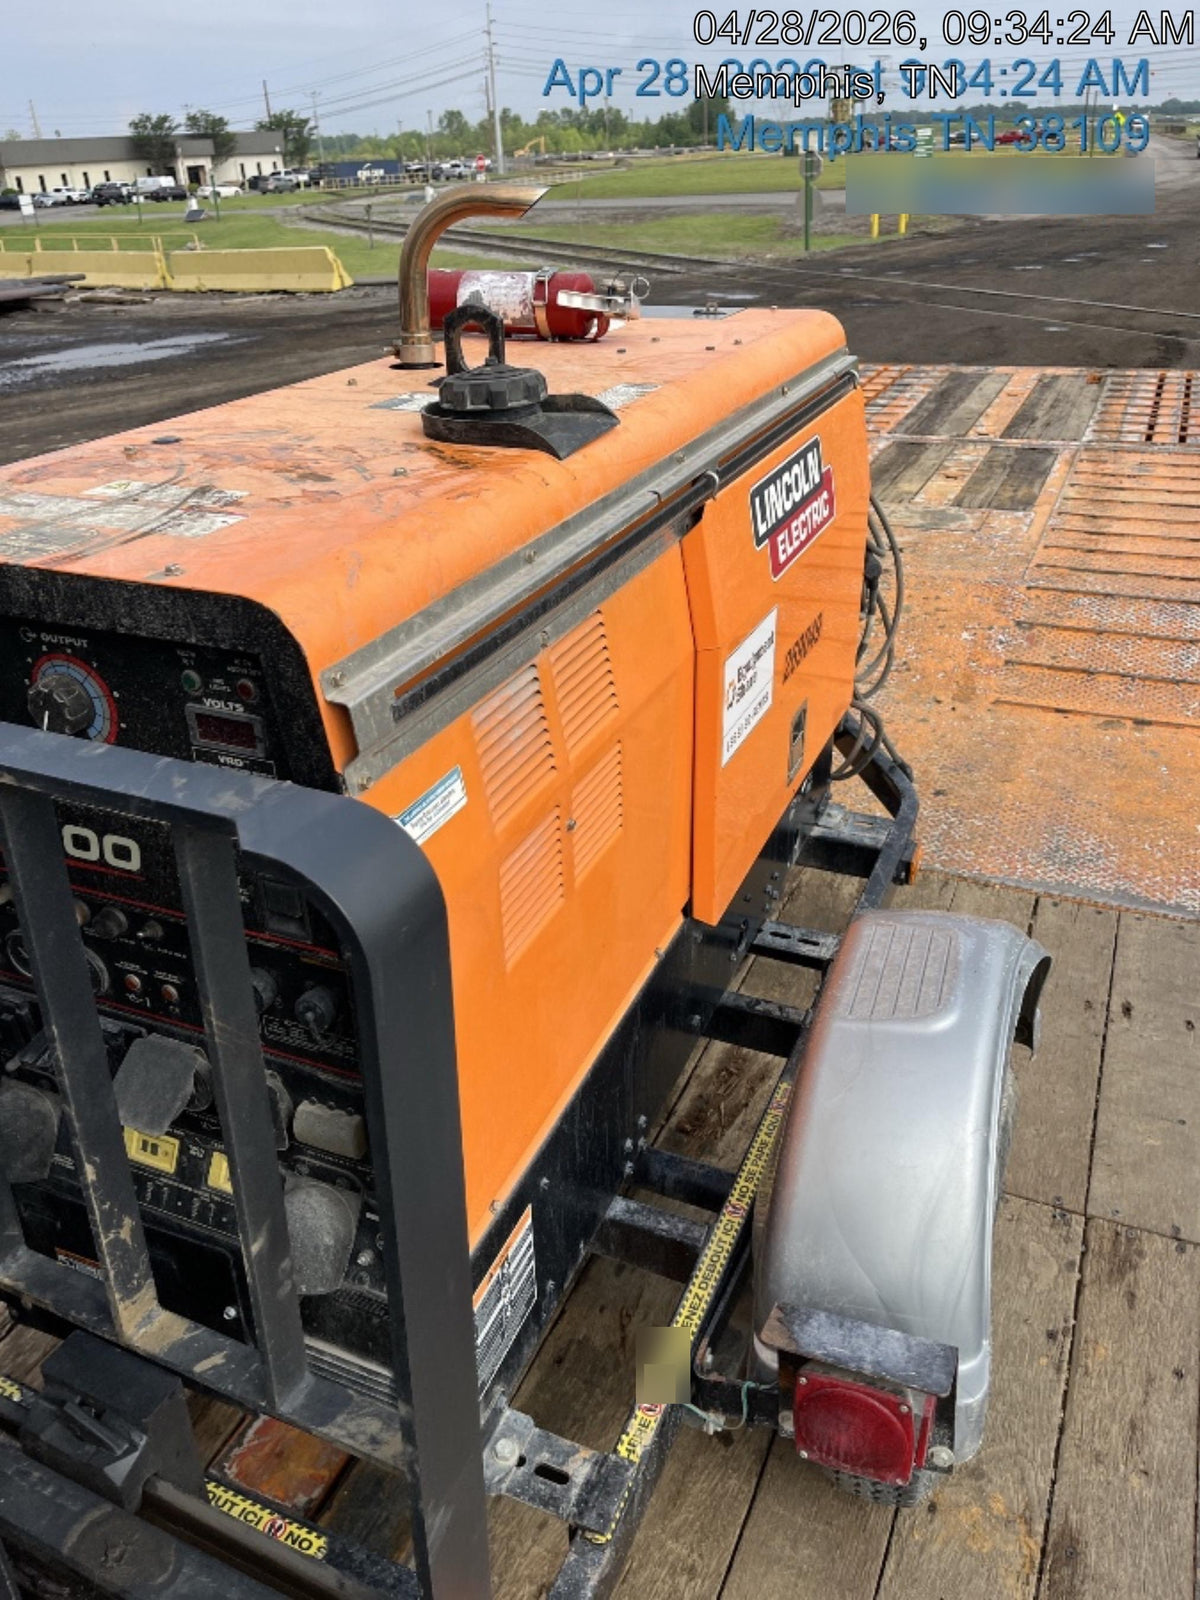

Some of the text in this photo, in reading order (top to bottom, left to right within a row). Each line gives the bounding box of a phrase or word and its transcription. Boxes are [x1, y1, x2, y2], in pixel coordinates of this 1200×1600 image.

[754, 448, 821, 537] LINCOLN
[777, 491, 830, 565] ELECTRIC
[40, 633, 88, 647] OUTPUT
[202, 698, 244, 712] VOLTS
[698, 1240, 728, 1291] DEBOUT
[238, 1507, 264, 1526] ICI
[284, 1531, 314, 1551] NO
